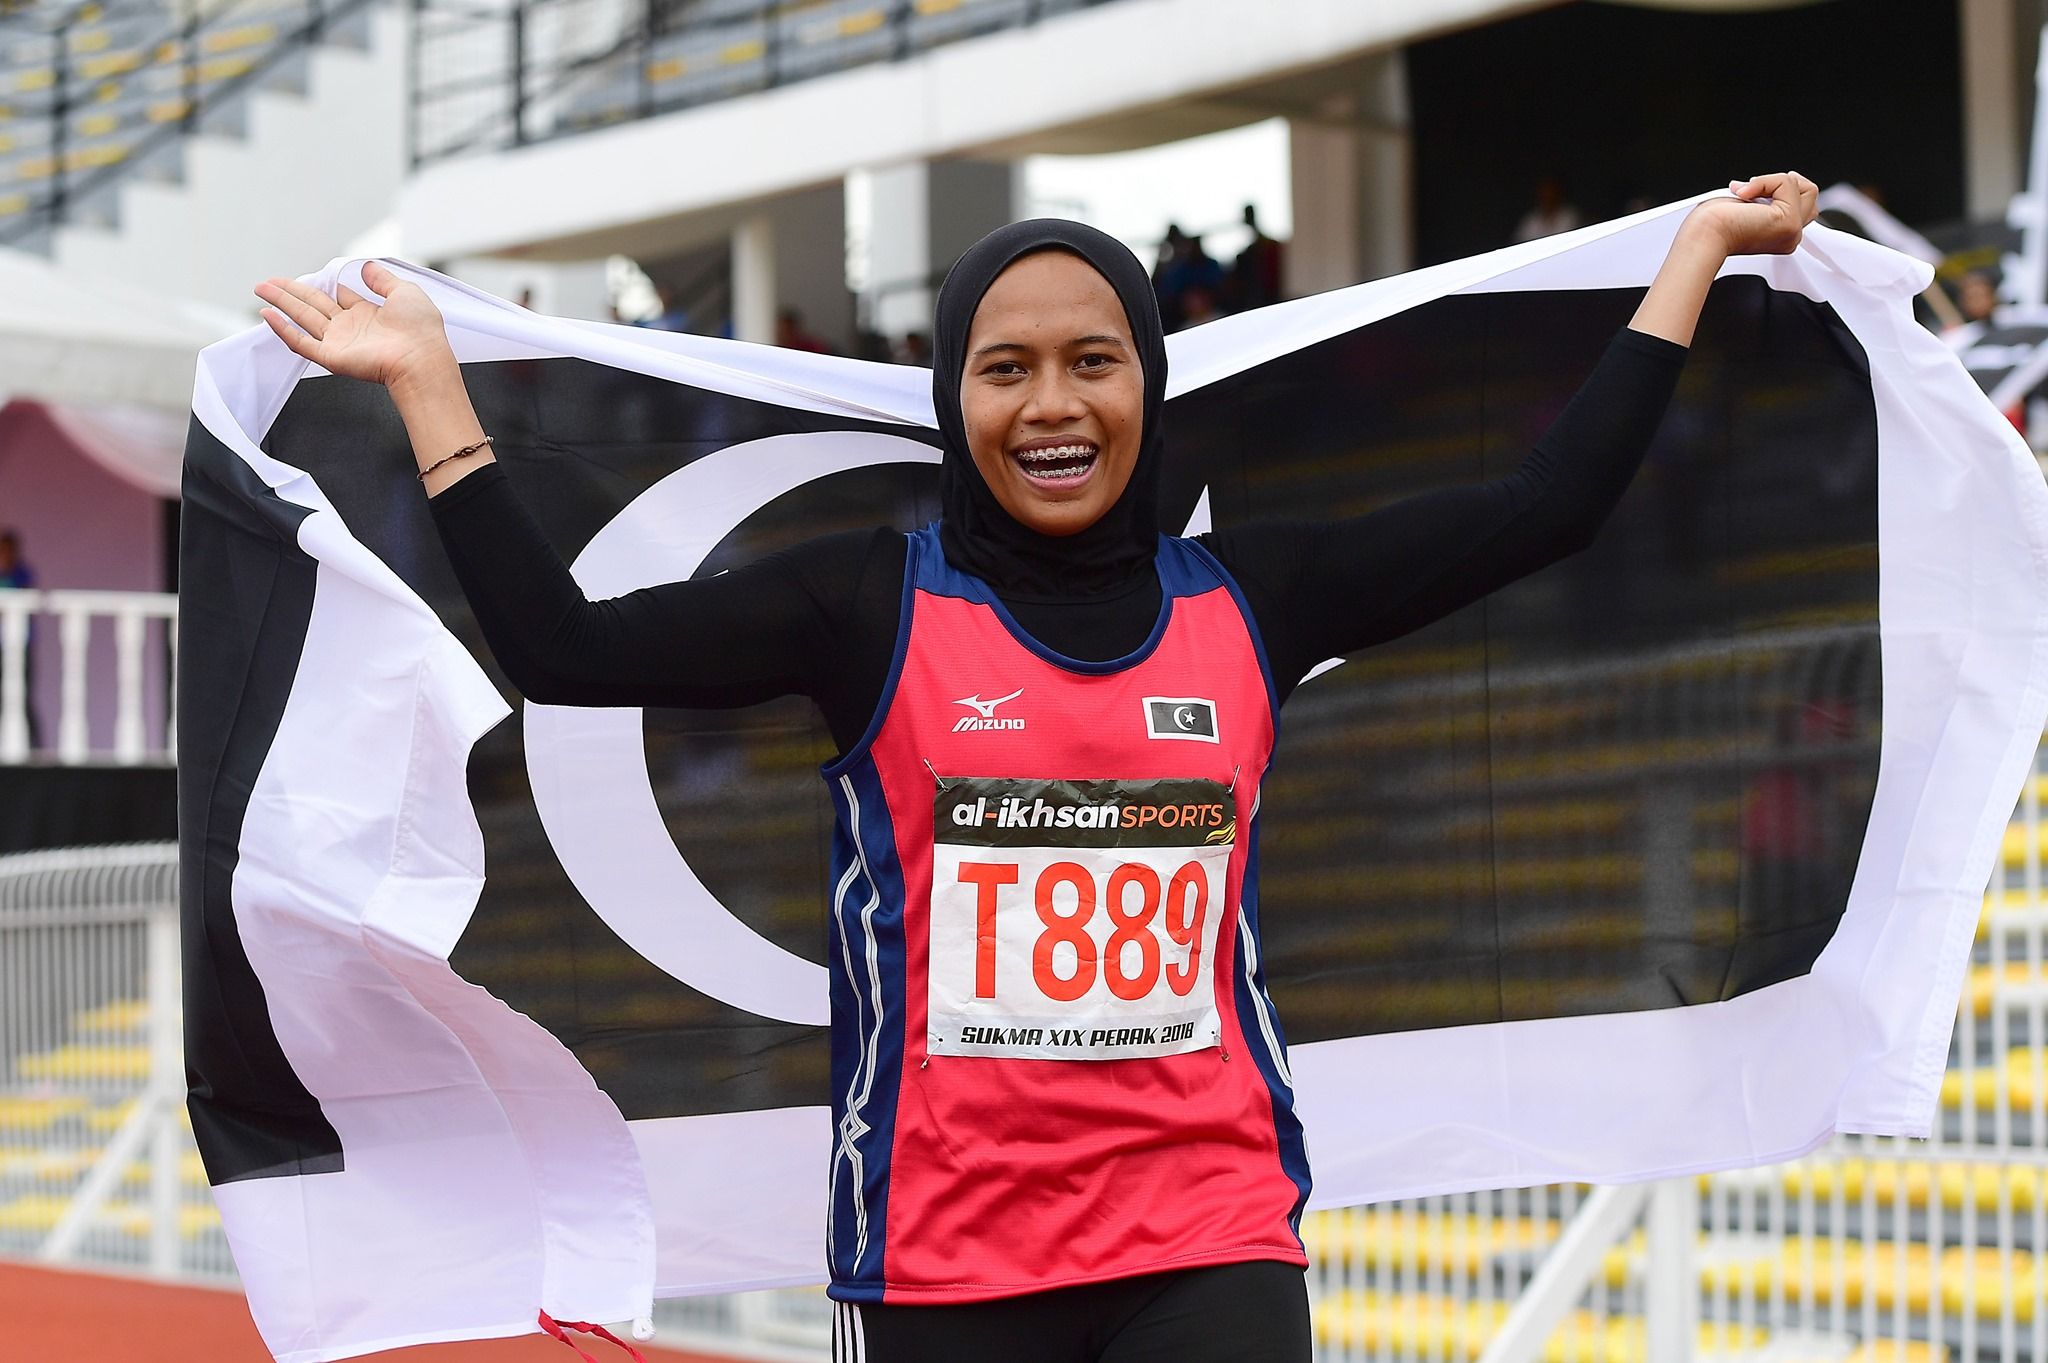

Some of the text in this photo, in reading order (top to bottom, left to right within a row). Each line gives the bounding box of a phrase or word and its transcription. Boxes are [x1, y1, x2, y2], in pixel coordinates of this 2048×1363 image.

[961, 1022, 1193, 1046] SUKMA XIX PERAK 2018
